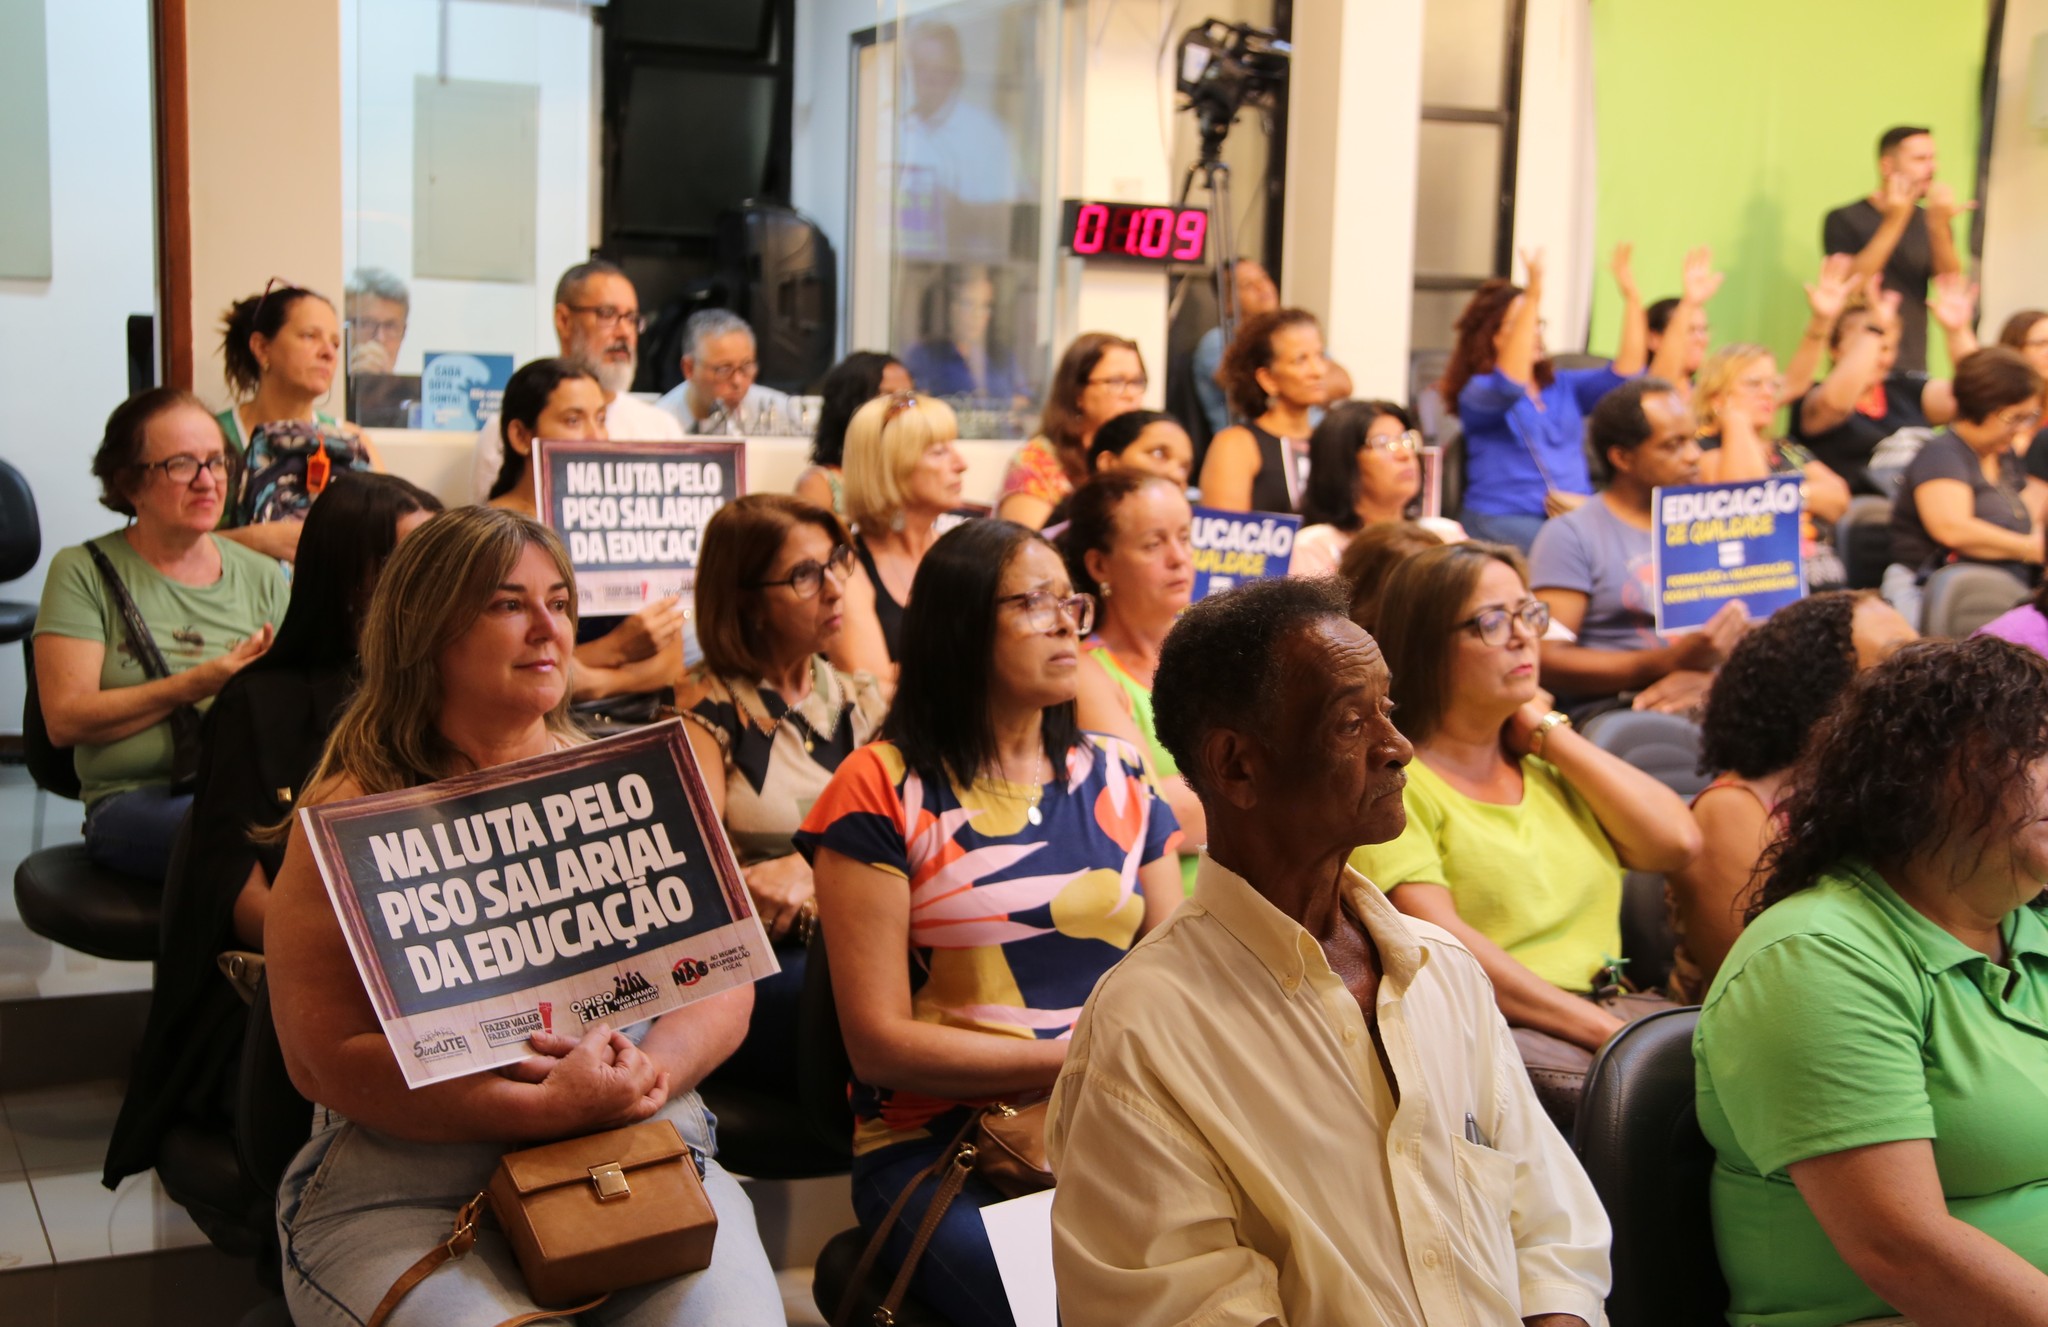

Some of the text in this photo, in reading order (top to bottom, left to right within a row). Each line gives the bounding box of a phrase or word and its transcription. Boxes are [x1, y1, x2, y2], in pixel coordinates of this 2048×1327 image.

[566, 462, 723, 495] NA LUTA PELO
[562, 496, 725, 530] PISO SALARIA
[1661, 480, 1799, 526] EDUCAÇÃO
[569, 527, 703, 567] DA EDUCAÇ
[1190, 516, 1295, 558] UCAÇÃO
[1666, 522, 1690, 547] DE
[1191, 548, 1268, 577] UALIDADE
[368, 773, 655, 882] NA LUTA PELO
[376, 823, 687, 940] PISO SALARIAL
[404, 875, 695, 994] DA EDUCAÇÃO
[709, 951, 751, 969] RECUPERAÇÃO
[722, 962, 742, 972] FISCAL
[671, 960, 709, 986] NÃO
[570, 991, 614, 1013] O PISO
[613, 985, 658, 1006] NÃO VAMOS
[619, 993, 659, 1011] ABRIR MÃO!
[484, 1013, 541, 1033] FAZER VALER
[579, 1005, 616, 1024] É LEI.
[488, 1029, 512, 1041] FAZER
[511, 1022, 544, 1036] CUMPRIR
[413, 1036, 467, 1058] SindUTE
